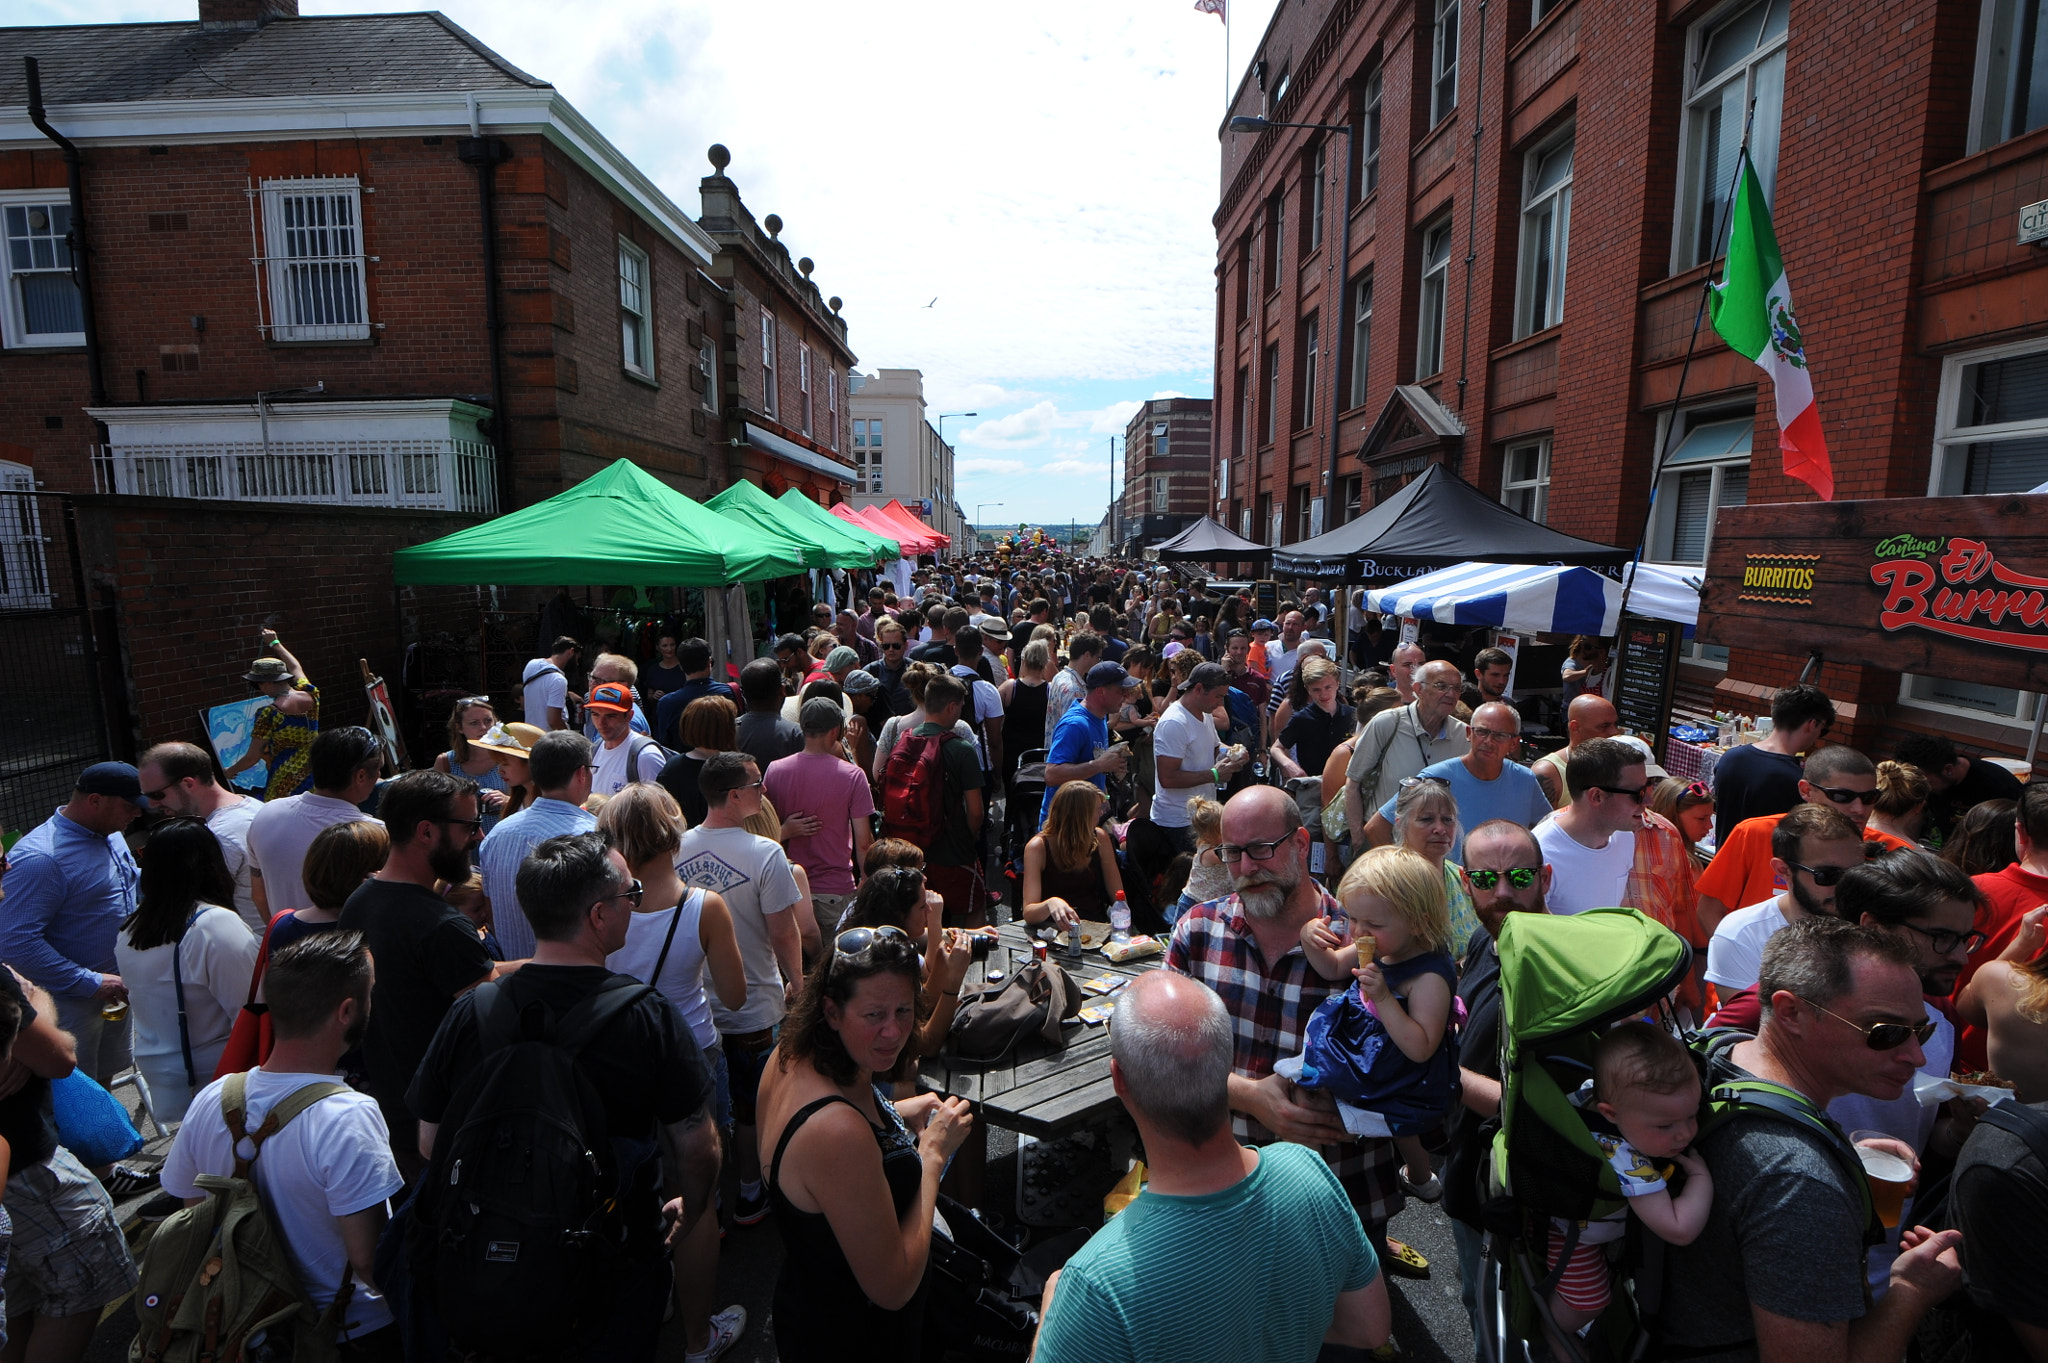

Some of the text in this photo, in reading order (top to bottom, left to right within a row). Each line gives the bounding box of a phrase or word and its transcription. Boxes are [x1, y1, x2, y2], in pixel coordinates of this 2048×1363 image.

[2023, 211, 2048, 230] CIT
[1875, 534, 1945, 558] Cantina
[1357, 559, 1439, 578] BUCKLAN
[1940, 537, 1993, 584] El
[1743, 566, 1815, 590] BURRITOS
[1870, 560, 2048, 632] Burri
